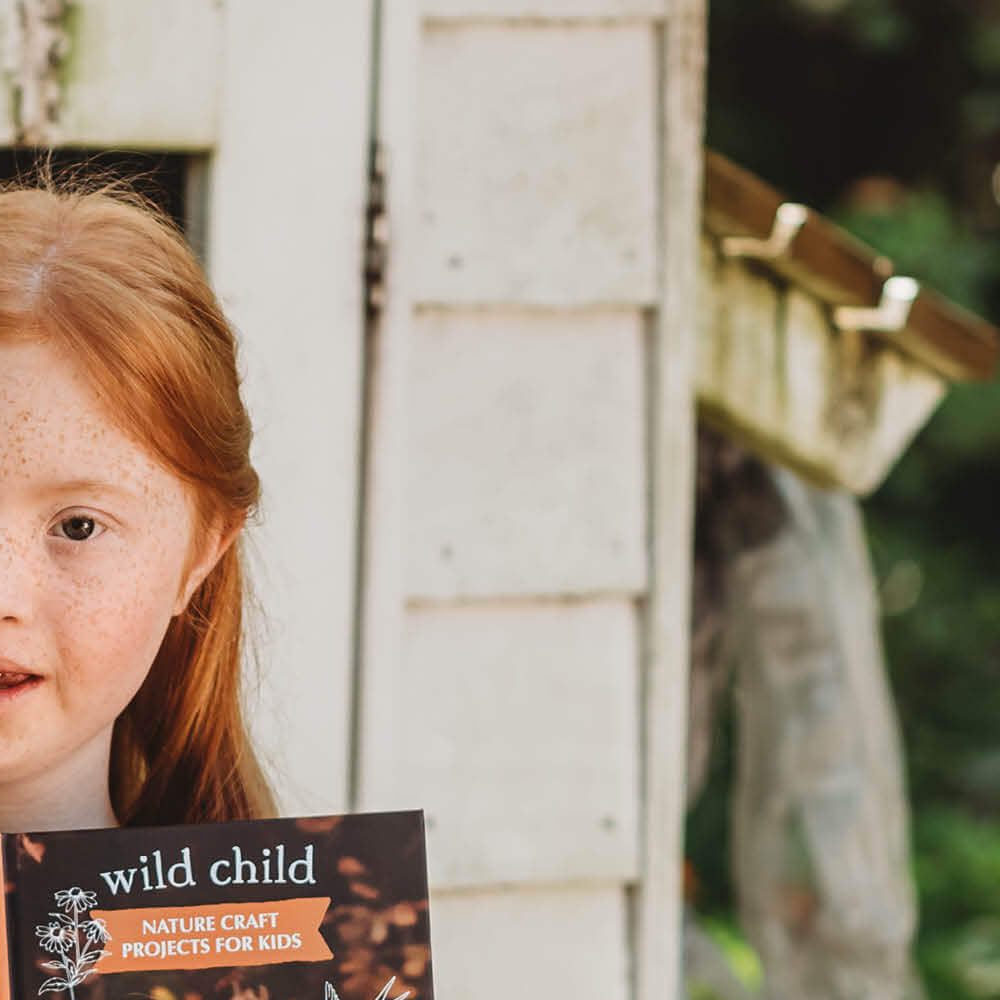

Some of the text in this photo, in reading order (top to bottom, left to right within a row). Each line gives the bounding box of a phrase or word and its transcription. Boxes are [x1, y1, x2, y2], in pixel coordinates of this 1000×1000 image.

[100, 844, 317, 896] wild child
[142, 912, 279, 935] NATURE CRAFT
[121, 933, 302, 959] PROJECTS FOR KIDS
